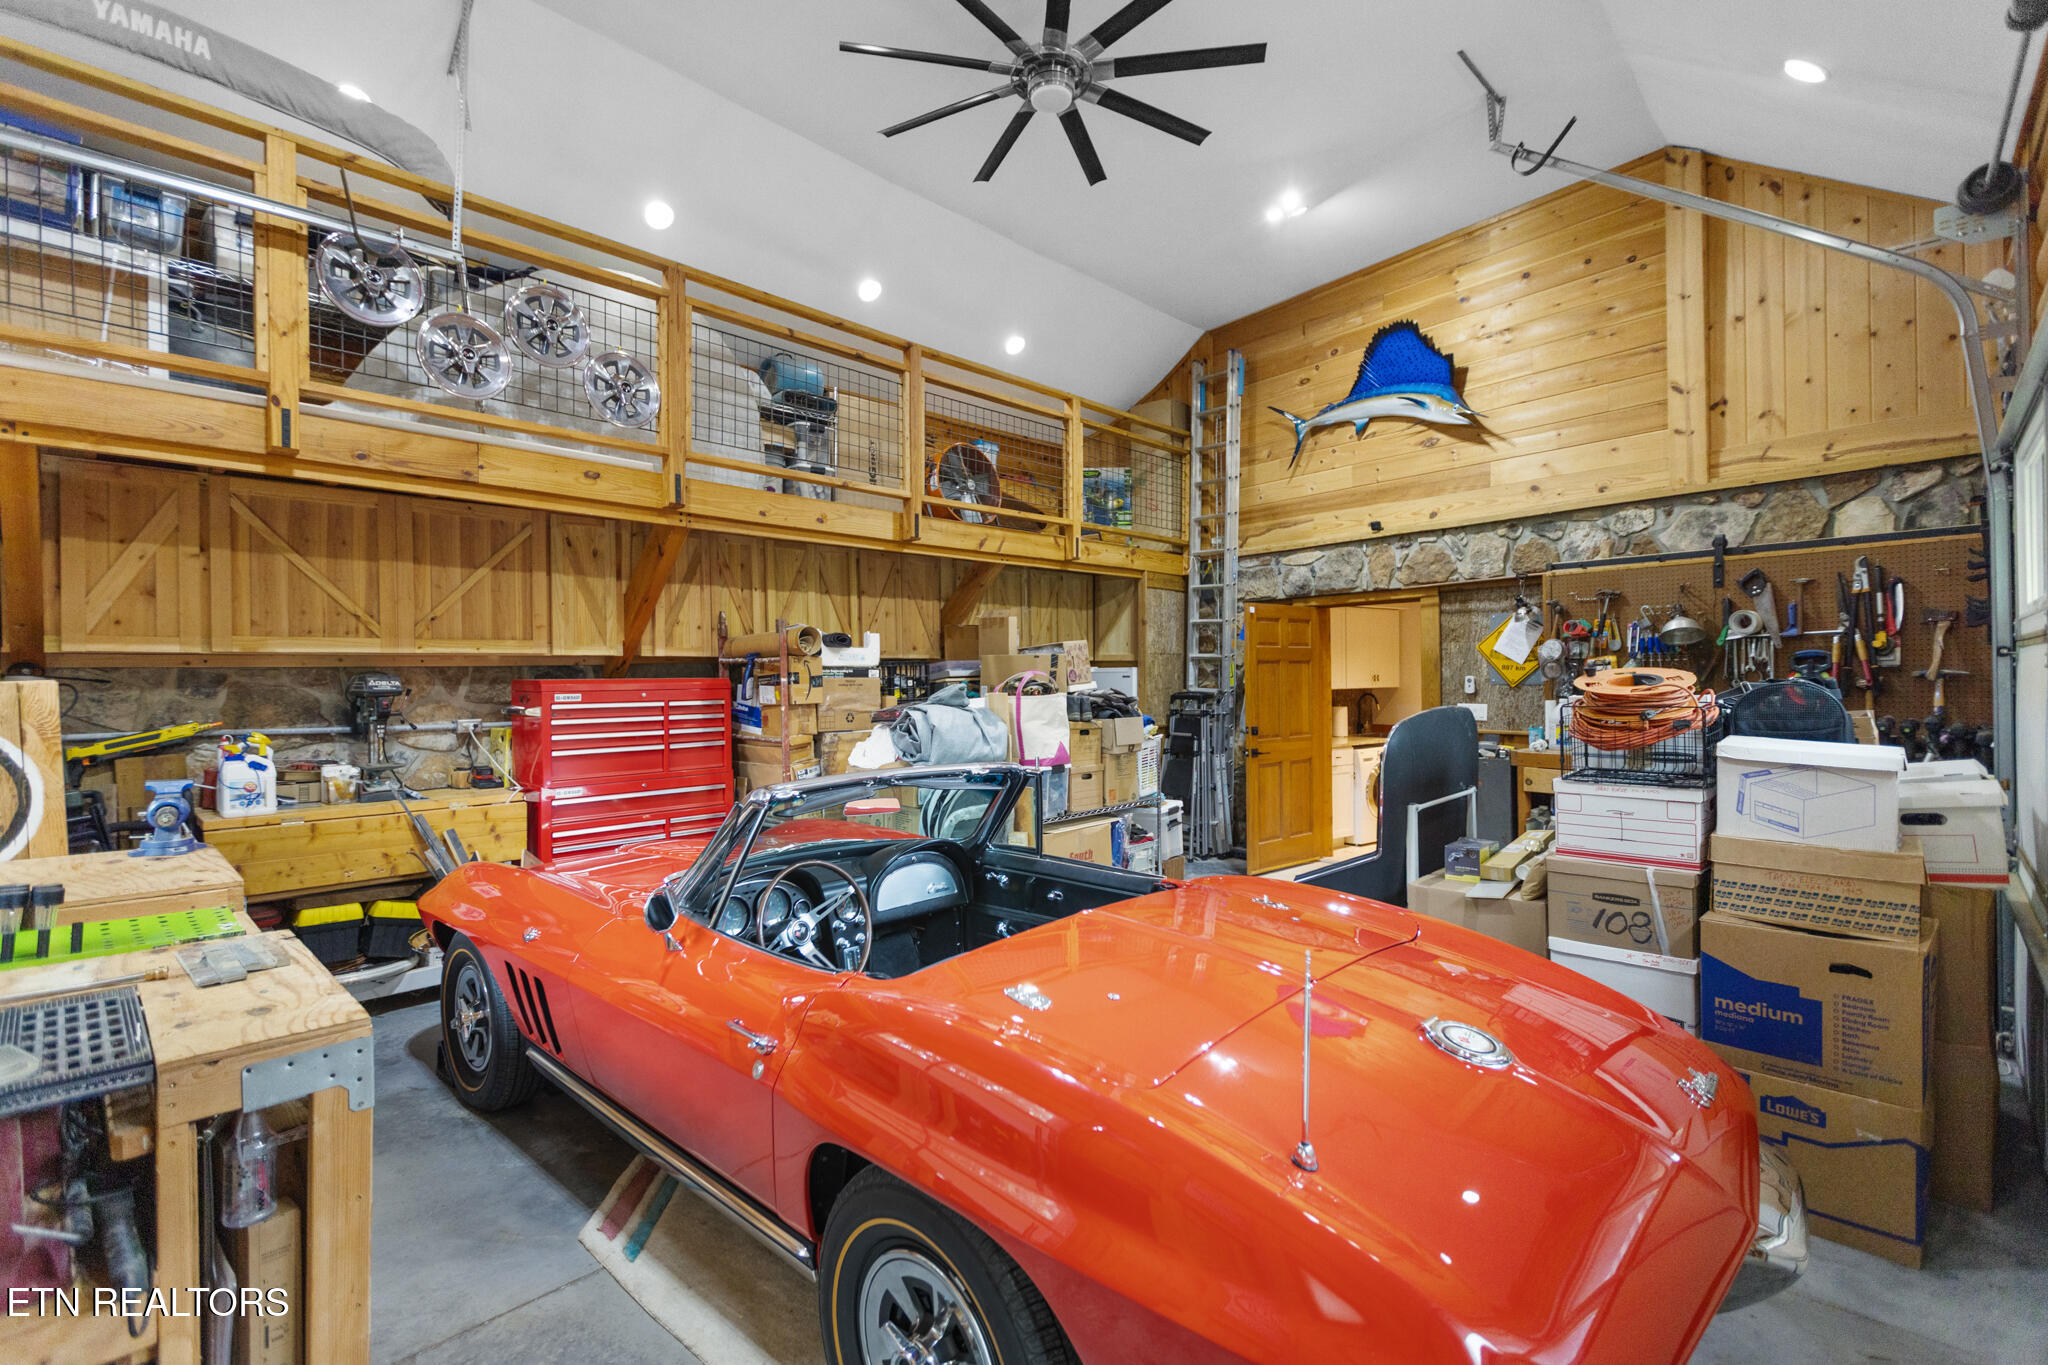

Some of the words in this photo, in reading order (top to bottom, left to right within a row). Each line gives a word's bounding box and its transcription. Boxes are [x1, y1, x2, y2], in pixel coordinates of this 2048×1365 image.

[93, 0, 211, 60] YAMAHA
[1592, 908, 1653, 944] 108
[1714, 996, 1803, 1025] medium
[1714, 1009, 1755, 1023] mediana
[1766, 1099, 1820, 1124] LOWE'S
